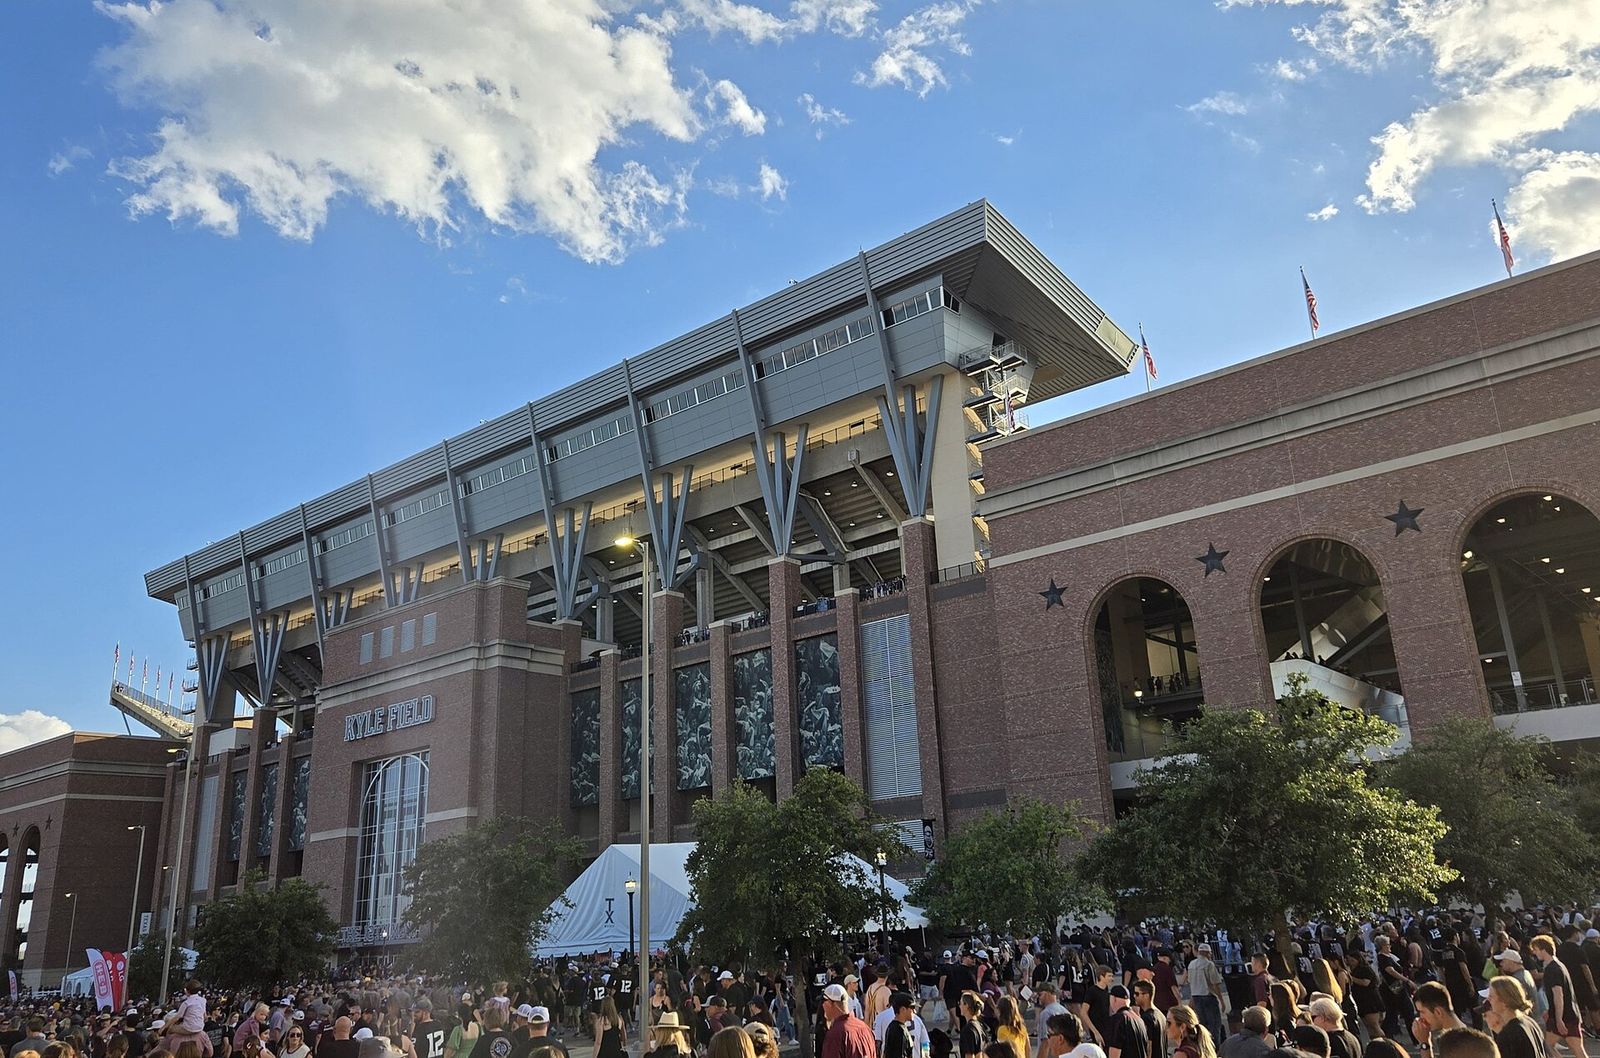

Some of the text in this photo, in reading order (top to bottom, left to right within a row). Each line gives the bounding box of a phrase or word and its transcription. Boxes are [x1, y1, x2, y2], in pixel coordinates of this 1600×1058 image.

[343, 694, 434, 742] KYLE FIELD
[1429, 929, 1442, 940] 12
[593, 986, 605, 1001] 12
[620, 979, 632, 993] 12
[426, 1030, 445, 1058] 12
